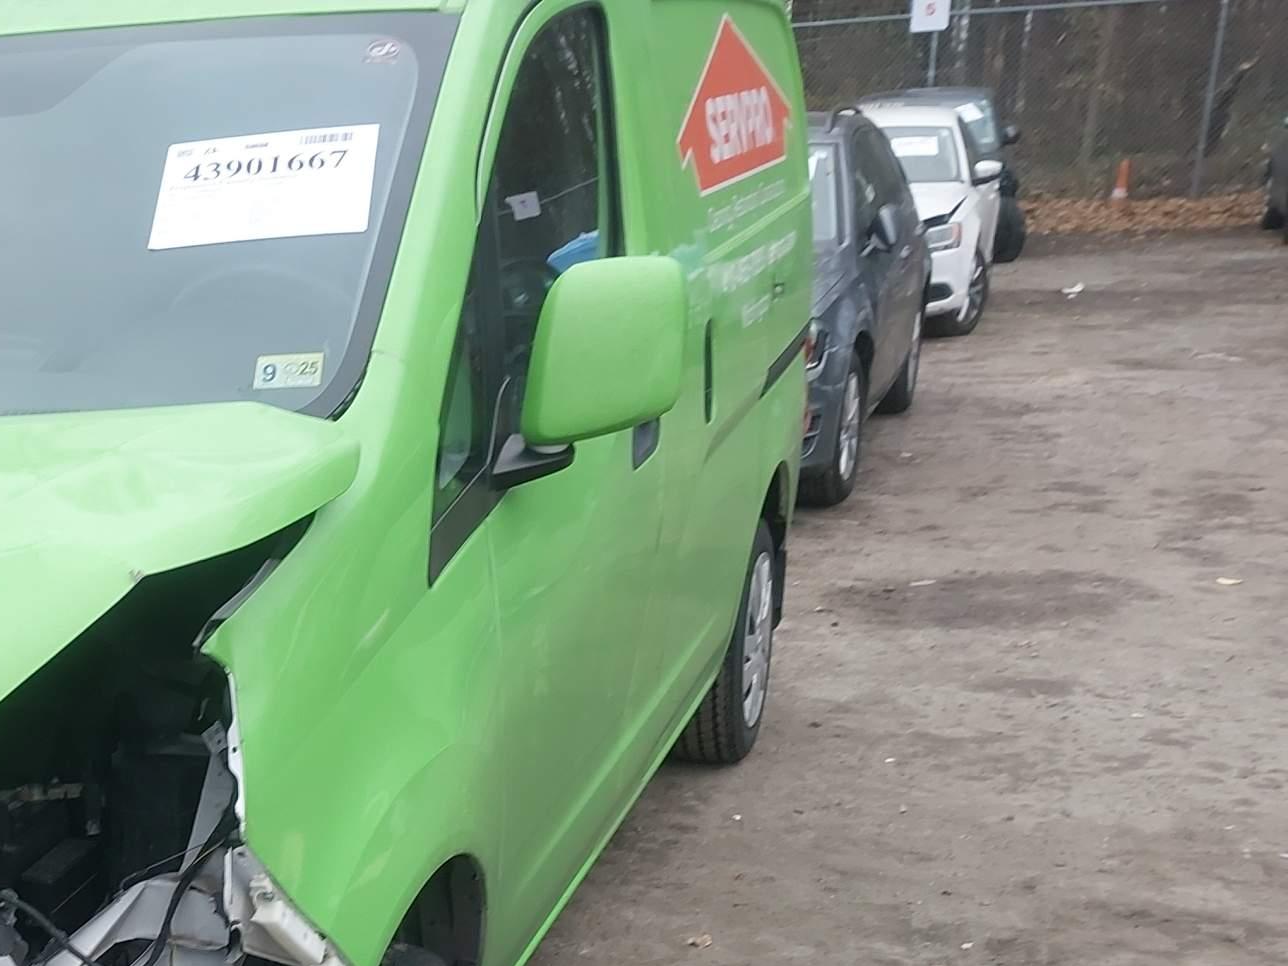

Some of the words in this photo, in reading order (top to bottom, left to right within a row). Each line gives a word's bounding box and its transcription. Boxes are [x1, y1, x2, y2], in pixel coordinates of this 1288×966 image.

[705, 86, 773, 164] SERVPRO
[183, 149, 350, 181] 43901667
[262, 363, 277, 382] 9
[297, 361, 320, 376] 25
